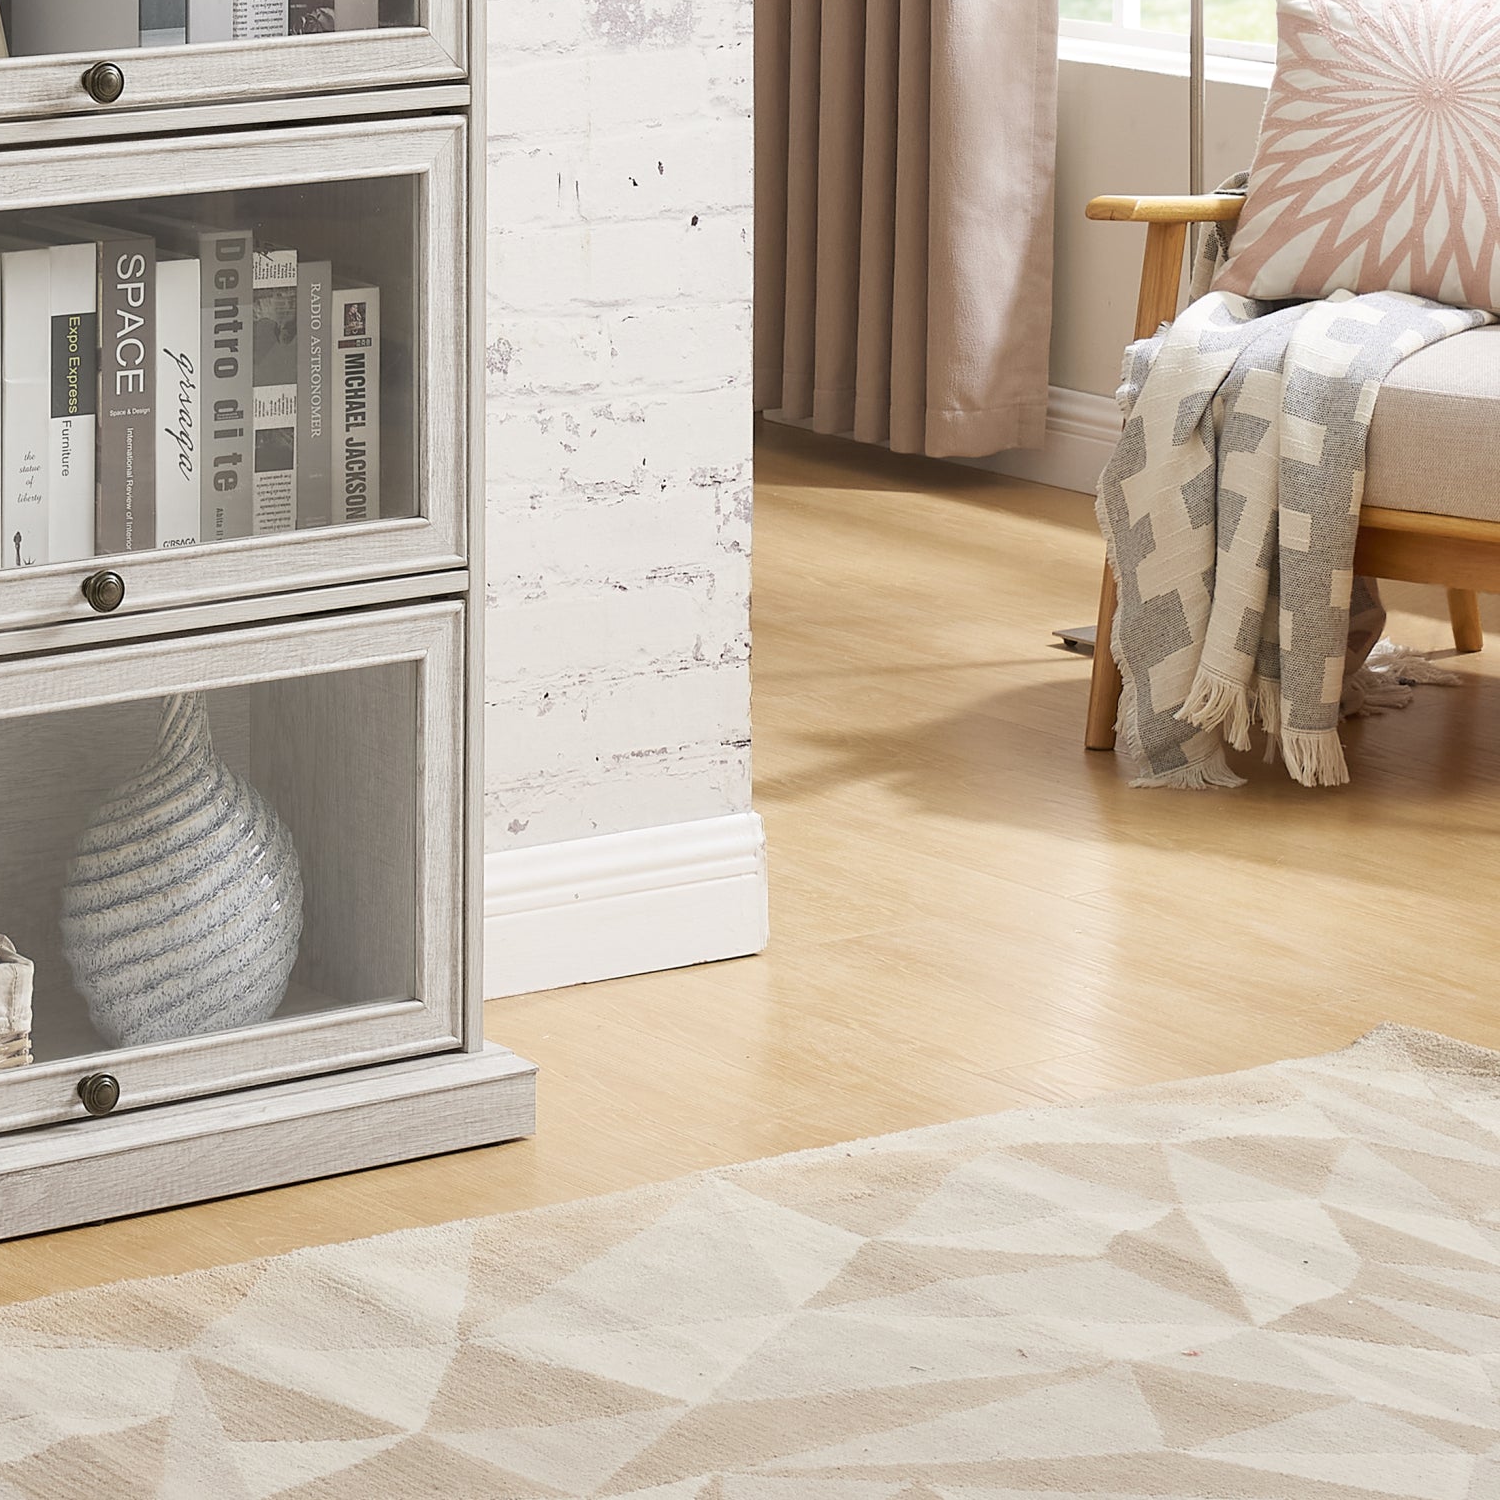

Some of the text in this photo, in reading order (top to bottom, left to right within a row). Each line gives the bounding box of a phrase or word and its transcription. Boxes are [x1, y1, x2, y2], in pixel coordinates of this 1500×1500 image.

[115, 253, 146, 395] SPACE
[213, 238, 246, 379] Dentro
[68, 316, 81, 415] Expo Express
[310, 283, 321, 438] RADIO ASTRONOMER
[109, 409, 126, 417] Space
[132, 407, 151, 415] Design
[344, 353, 366, 433] MICHAEL
[19, 465, 41, 473] statue
[24, 451, 35, 461] the
[60, 419, 73, 477] Furniture
[126, 427, 134, 478] International
[17, 493, 42, 504] liberty
[25, 475, 34, 488] of
[126, 480, 134, 510] Review
[345, 436, 367, 519] JACKSON
[126, 511, 133, 520] of
